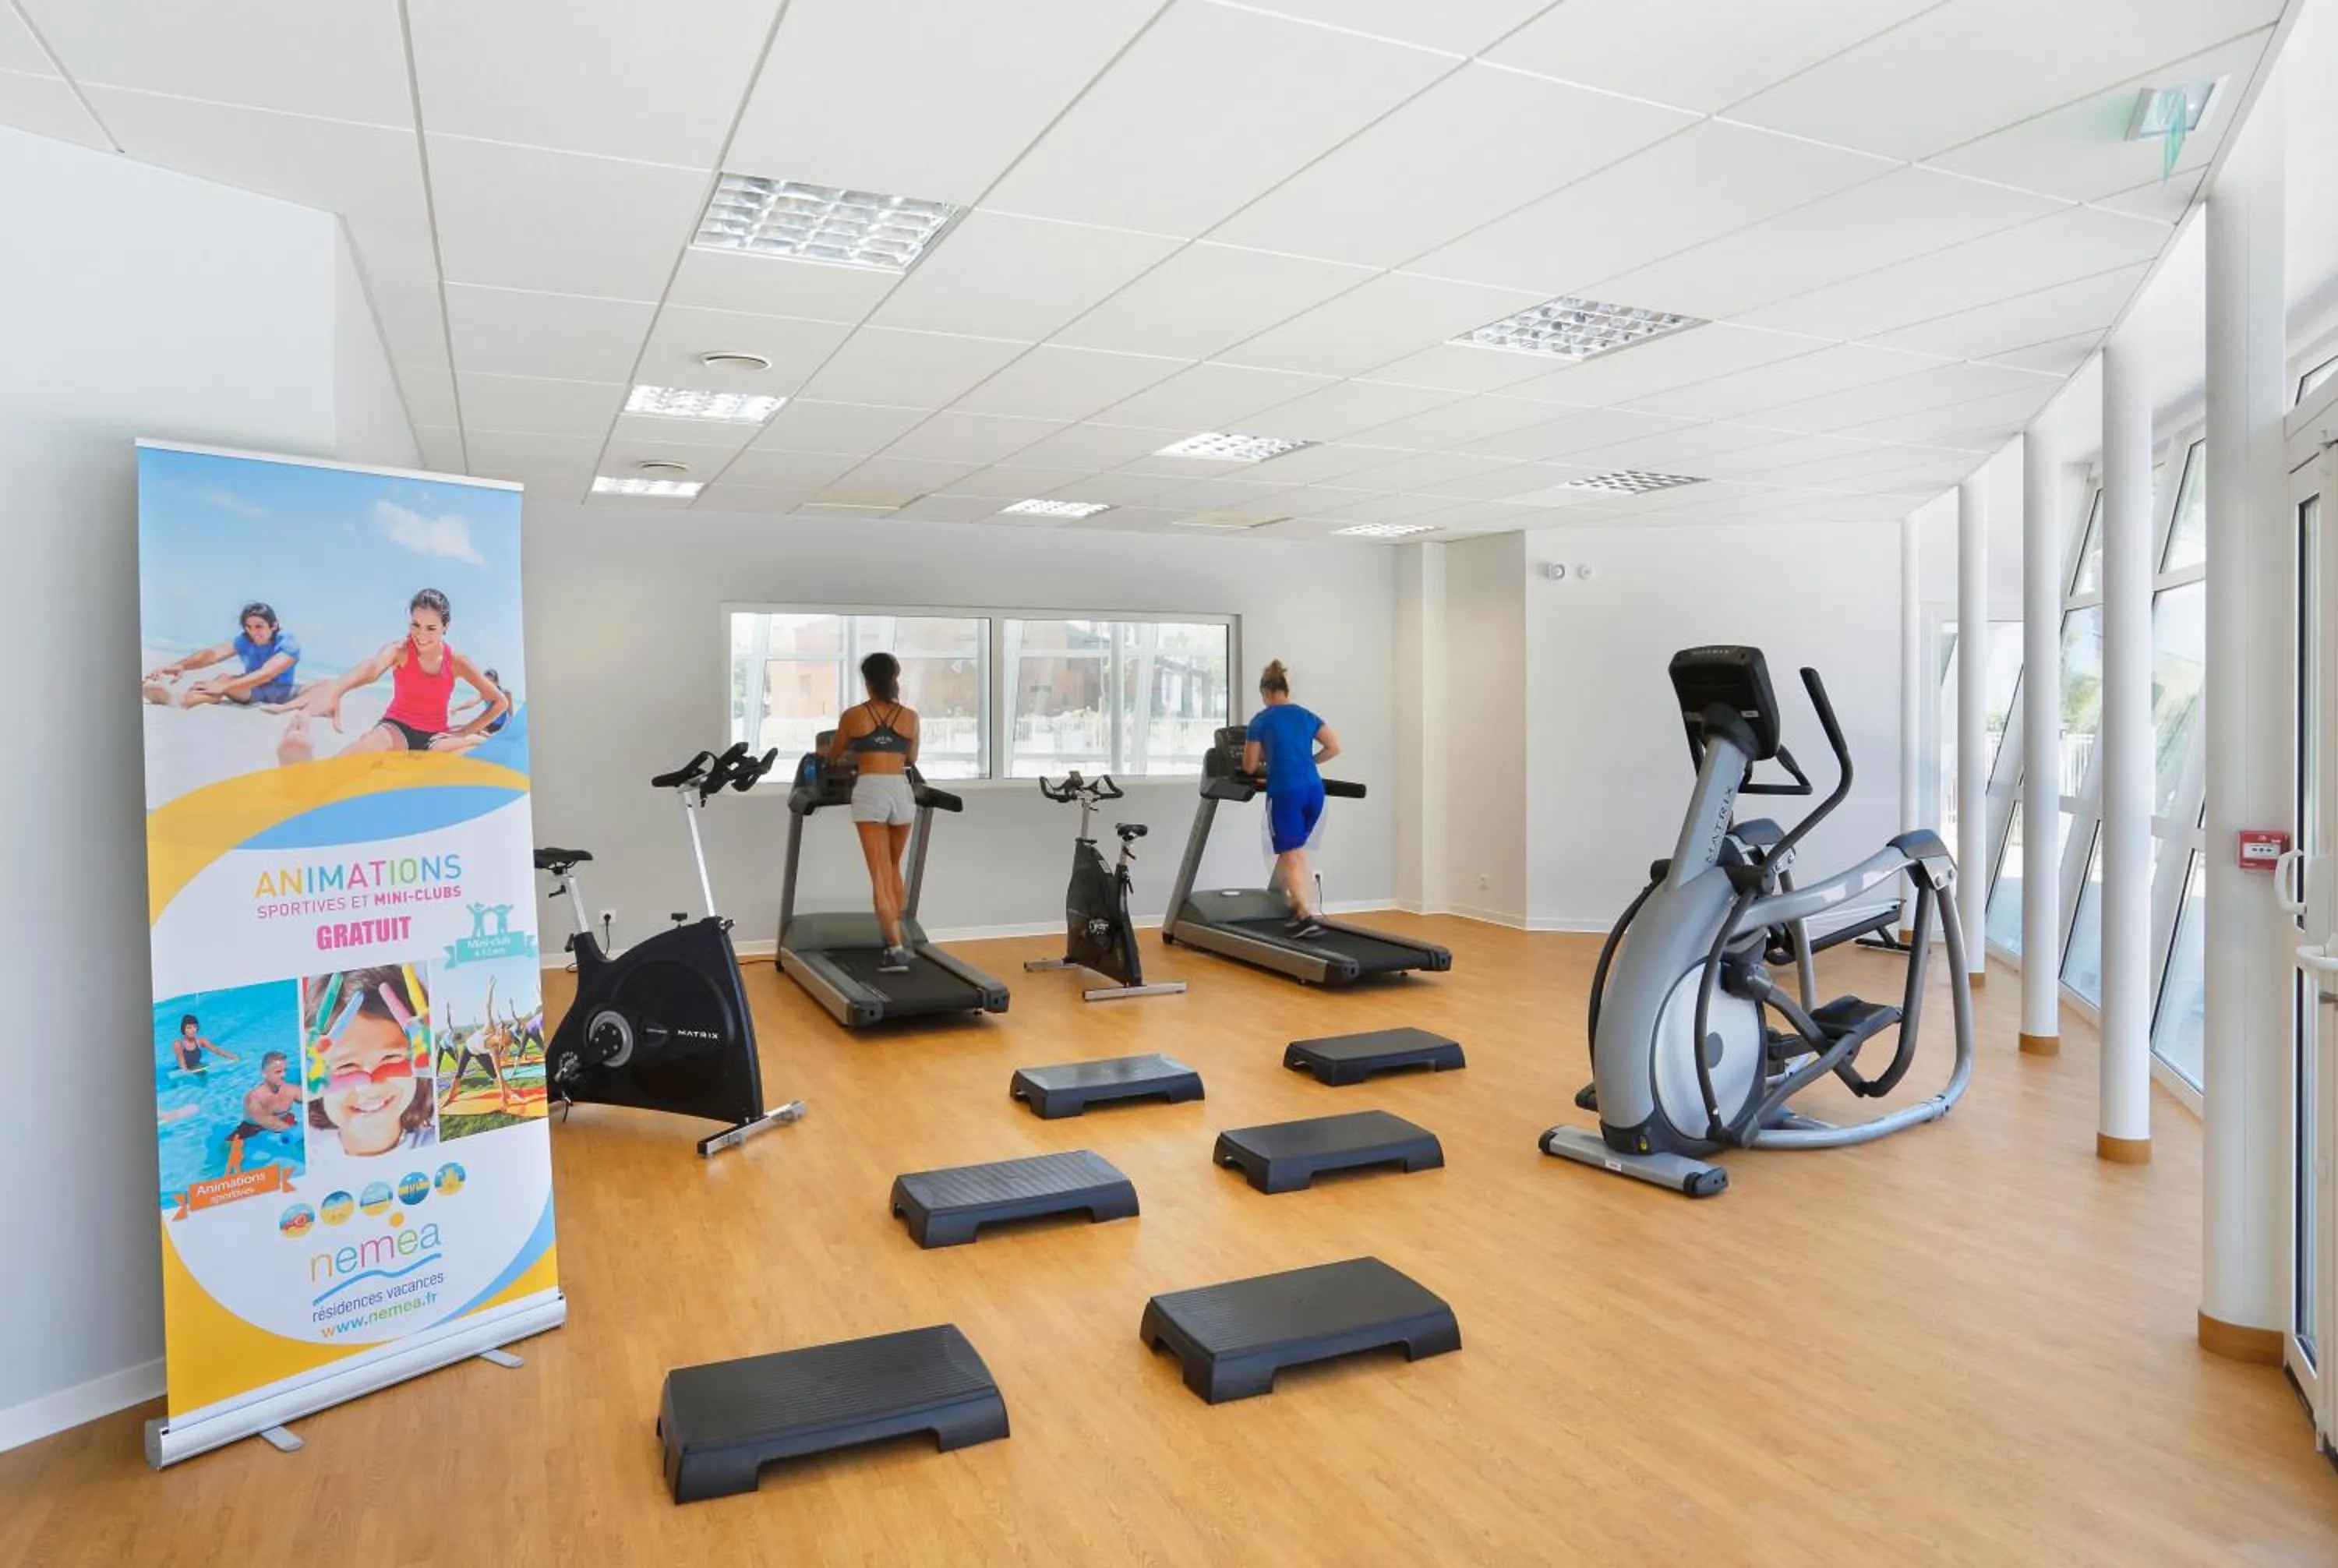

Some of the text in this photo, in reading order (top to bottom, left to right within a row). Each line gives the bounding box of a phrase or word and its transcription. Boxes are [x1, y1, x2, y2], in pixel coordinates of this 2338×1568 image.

[1704, 786, 1733, 863] MATRIX
[254, 854, 462, 899] ANIMATIONS
[257, 885, 461, 919] SPORTIVES ET MINI-CLUBS
[316, 916, 412, 950] GRATUIT
[677, 1029, 719, 1039] MATRIX
[197, 1172, 266, 1197] Animations
[313, 1222, 440, 1282] nemea
[313, 1272, 444, 1323] résidences vacances
[320, 1292, 438, 1338] www.nemea.fr
